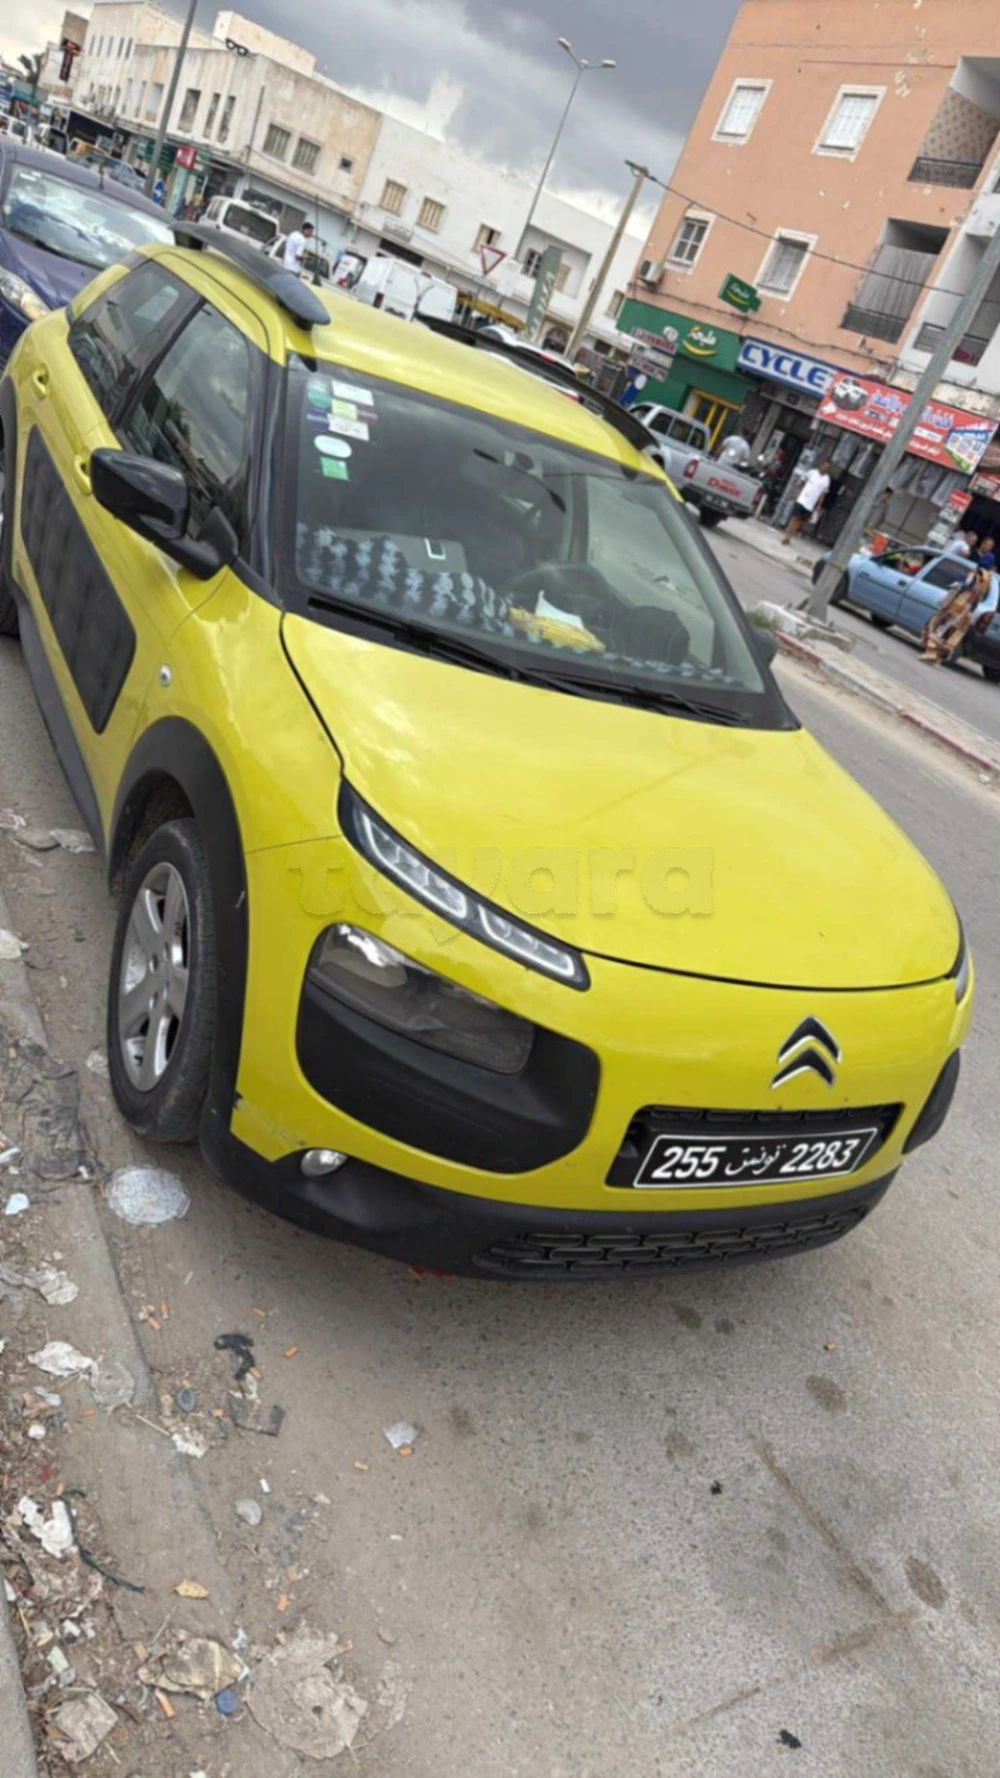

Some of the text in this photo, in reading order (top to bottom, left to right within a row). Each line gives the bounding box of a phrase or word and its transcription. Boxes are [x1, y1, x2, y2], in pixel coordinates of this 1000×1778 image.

[742, 343, 835, 391] CYCLE
[651, 1138, 860, 1179] 255 تونس 2283
